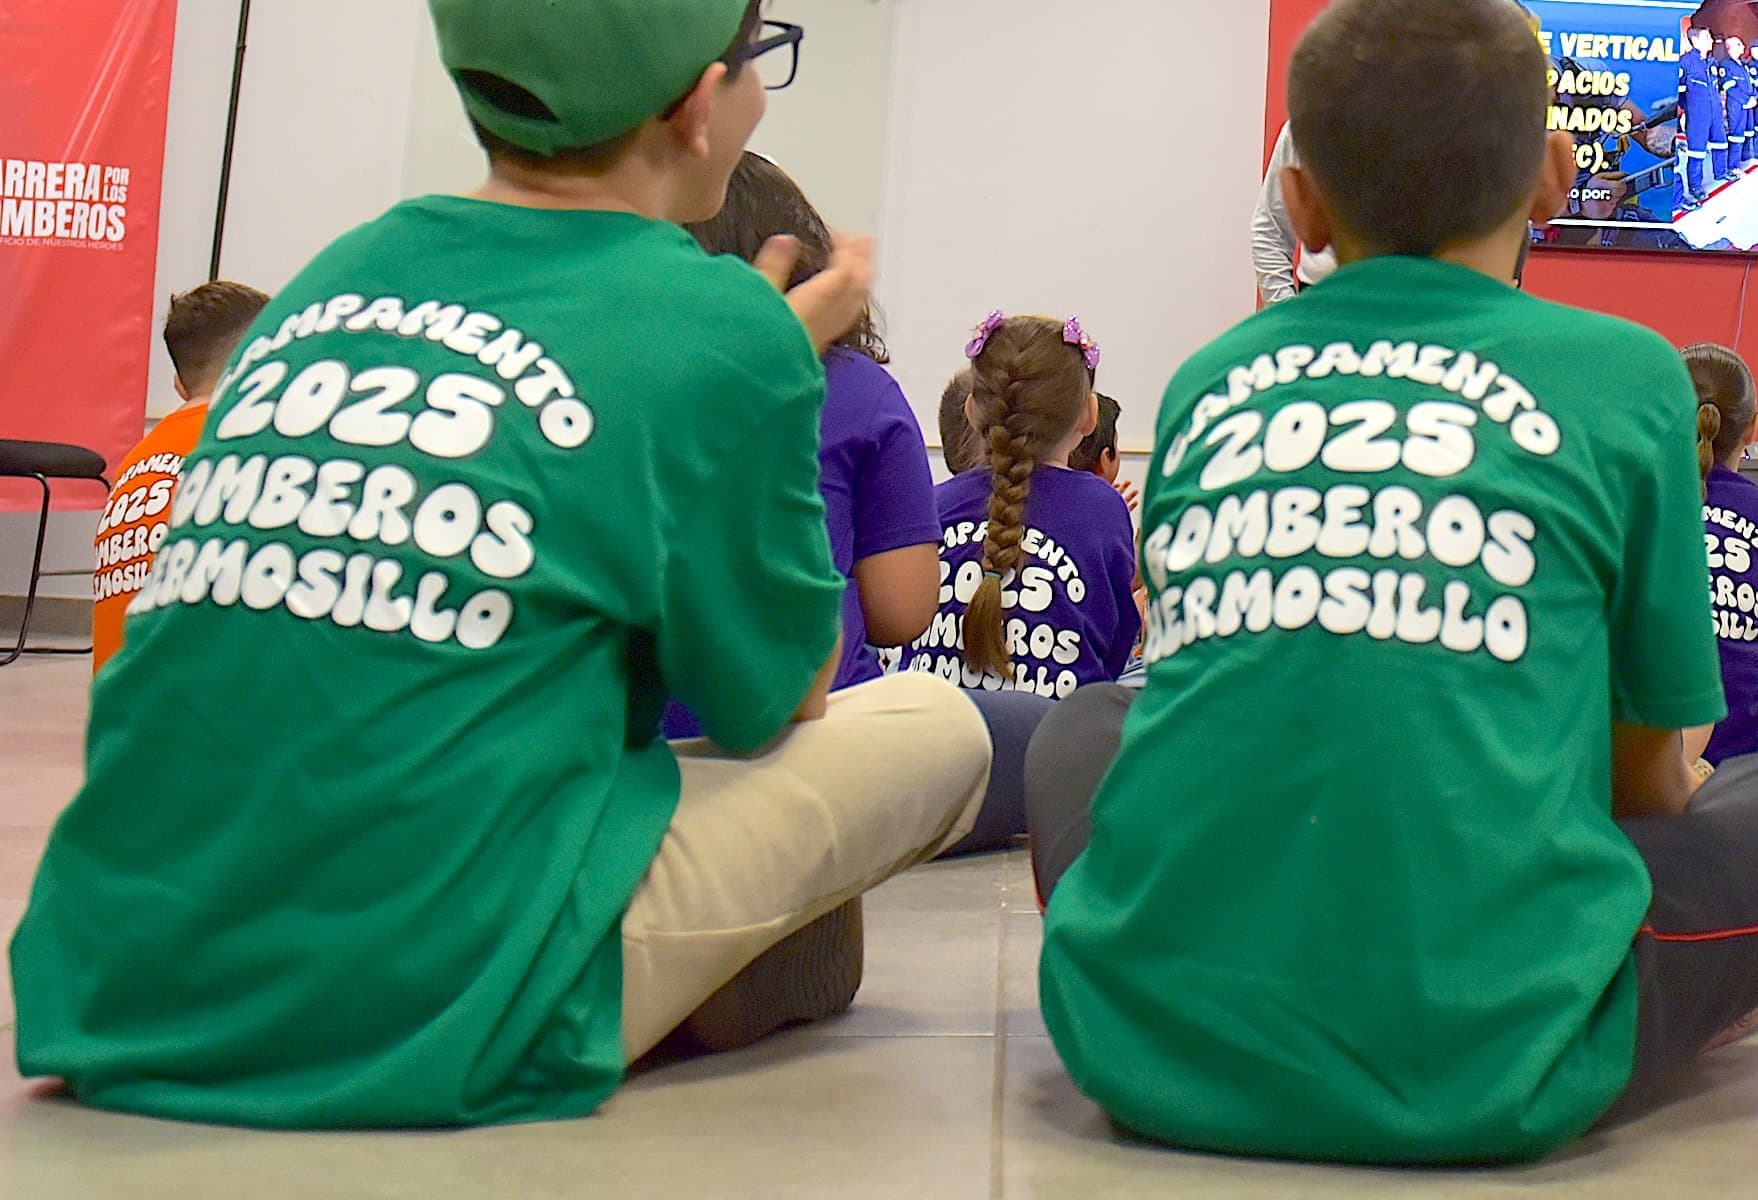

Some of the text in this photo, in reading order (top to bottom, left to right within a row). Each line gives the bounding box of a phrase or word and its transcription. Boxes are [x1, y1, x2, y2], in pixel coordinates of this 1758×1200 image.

[1559, 32, 1680, 62] VERTICAL
[1546, 68, 1631, 97] PACIOS
[1546, 105, 1633, 134] INADOS
[0, 158, 101, 202] RRERA
[103, 165, 130, 186] POR
[1571, 141, 1610, 175] C).
[102, 184, 128, 204] LOS
[1581, 188, 1612, 201] por:
[0, 198, 126, 242] MBEROS
[215, 357, 504, 459] 2025
[1162, 340, 1562, 478] CAMPAMENTO
[1199, 400, 1478, 491] 2025
[96, 479, 174, 536] 2025
[171, 452, 535, 579] OMBEROS
[95, 522, 169, 571] MBERO
[1144, 484, 1537, 591] BOMBEROS
[1703, 533, 1751, 574] 25
[94, 560, 152, 603] MOSIL
[938, 521, 1086, 604] MPAENTO
